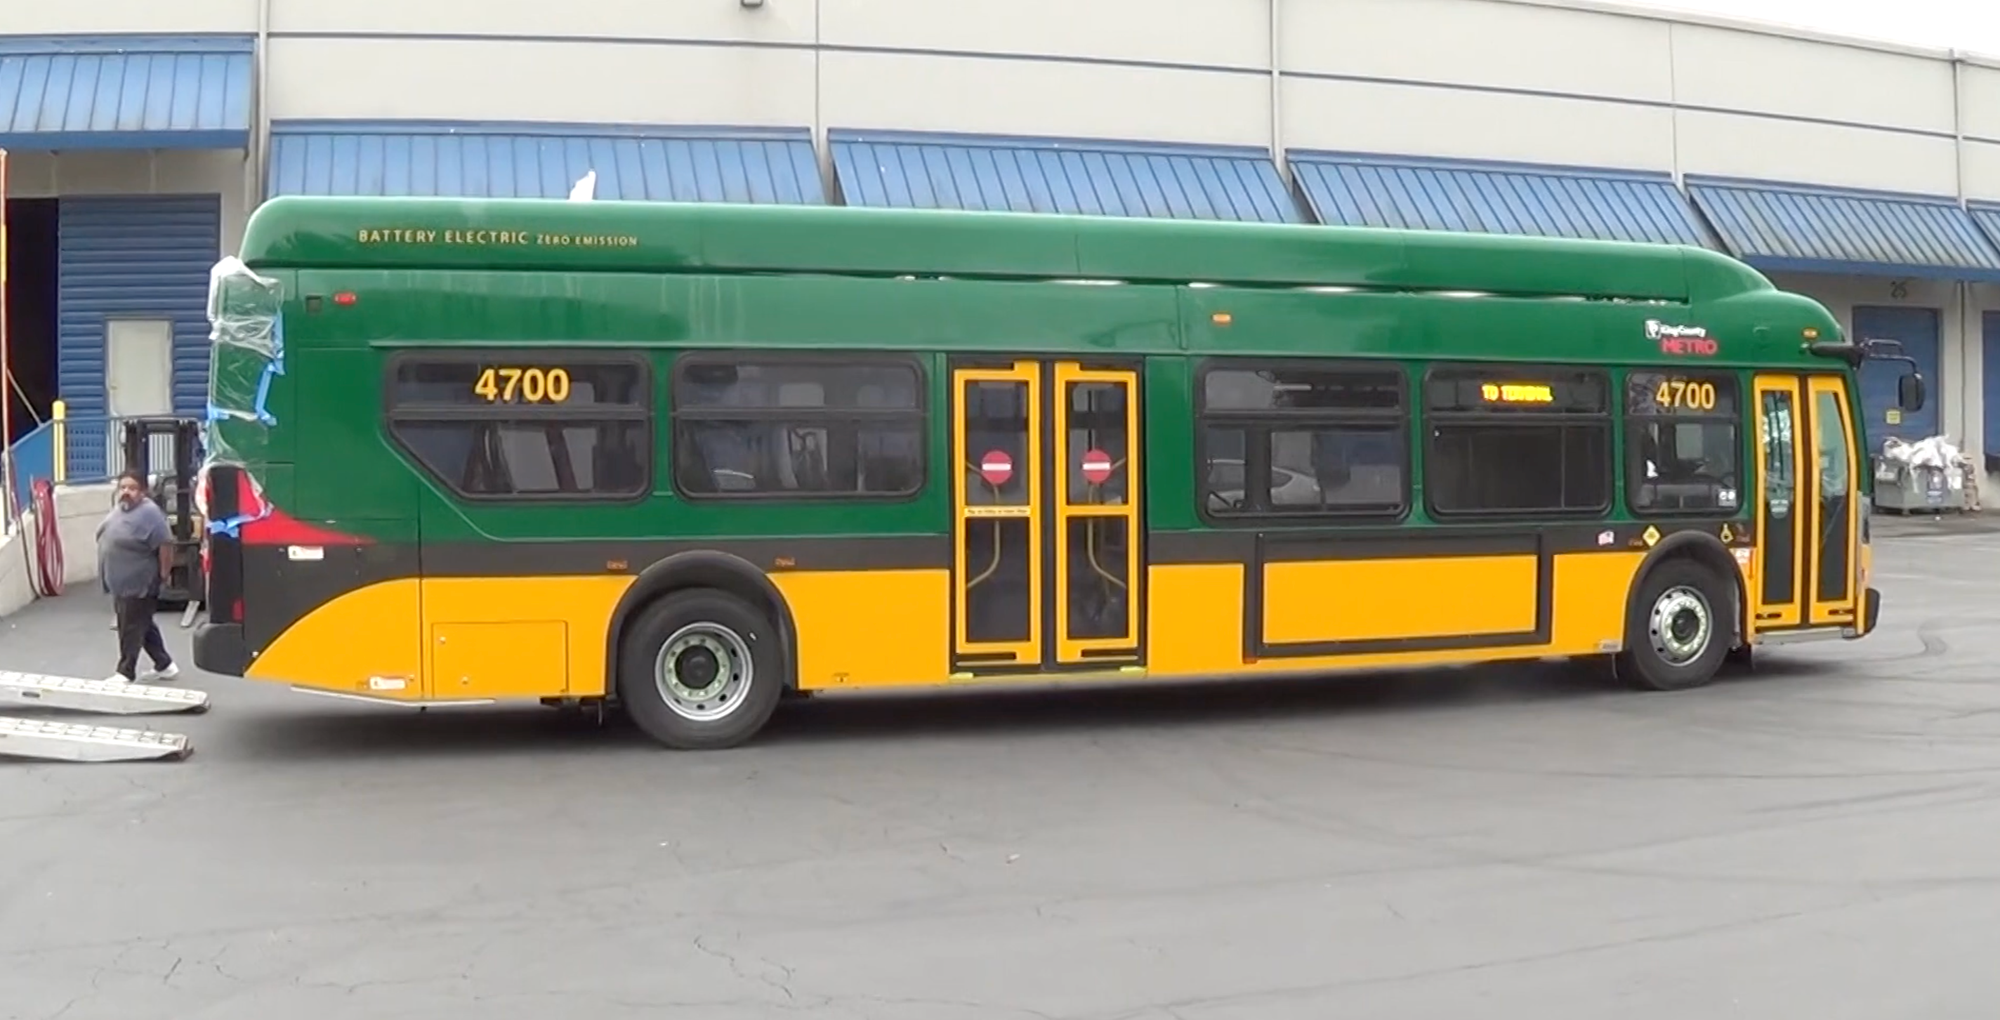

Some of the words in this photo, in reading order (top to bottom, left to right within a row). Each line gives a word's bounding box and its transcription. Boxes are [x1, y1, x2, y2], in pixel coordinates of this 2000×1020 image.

[358, 229, 437, 244] BATTERY
[444, 230, 529, 245] ELECTRIC
[536, 233, 570, 246] ZERO
[575, 235, 638, 247] EMISSION
[1661, 337, 1718, 355] METRO
[474, 367, 570, 402] 4700
[1655, 381, 1716, 410] 4700
